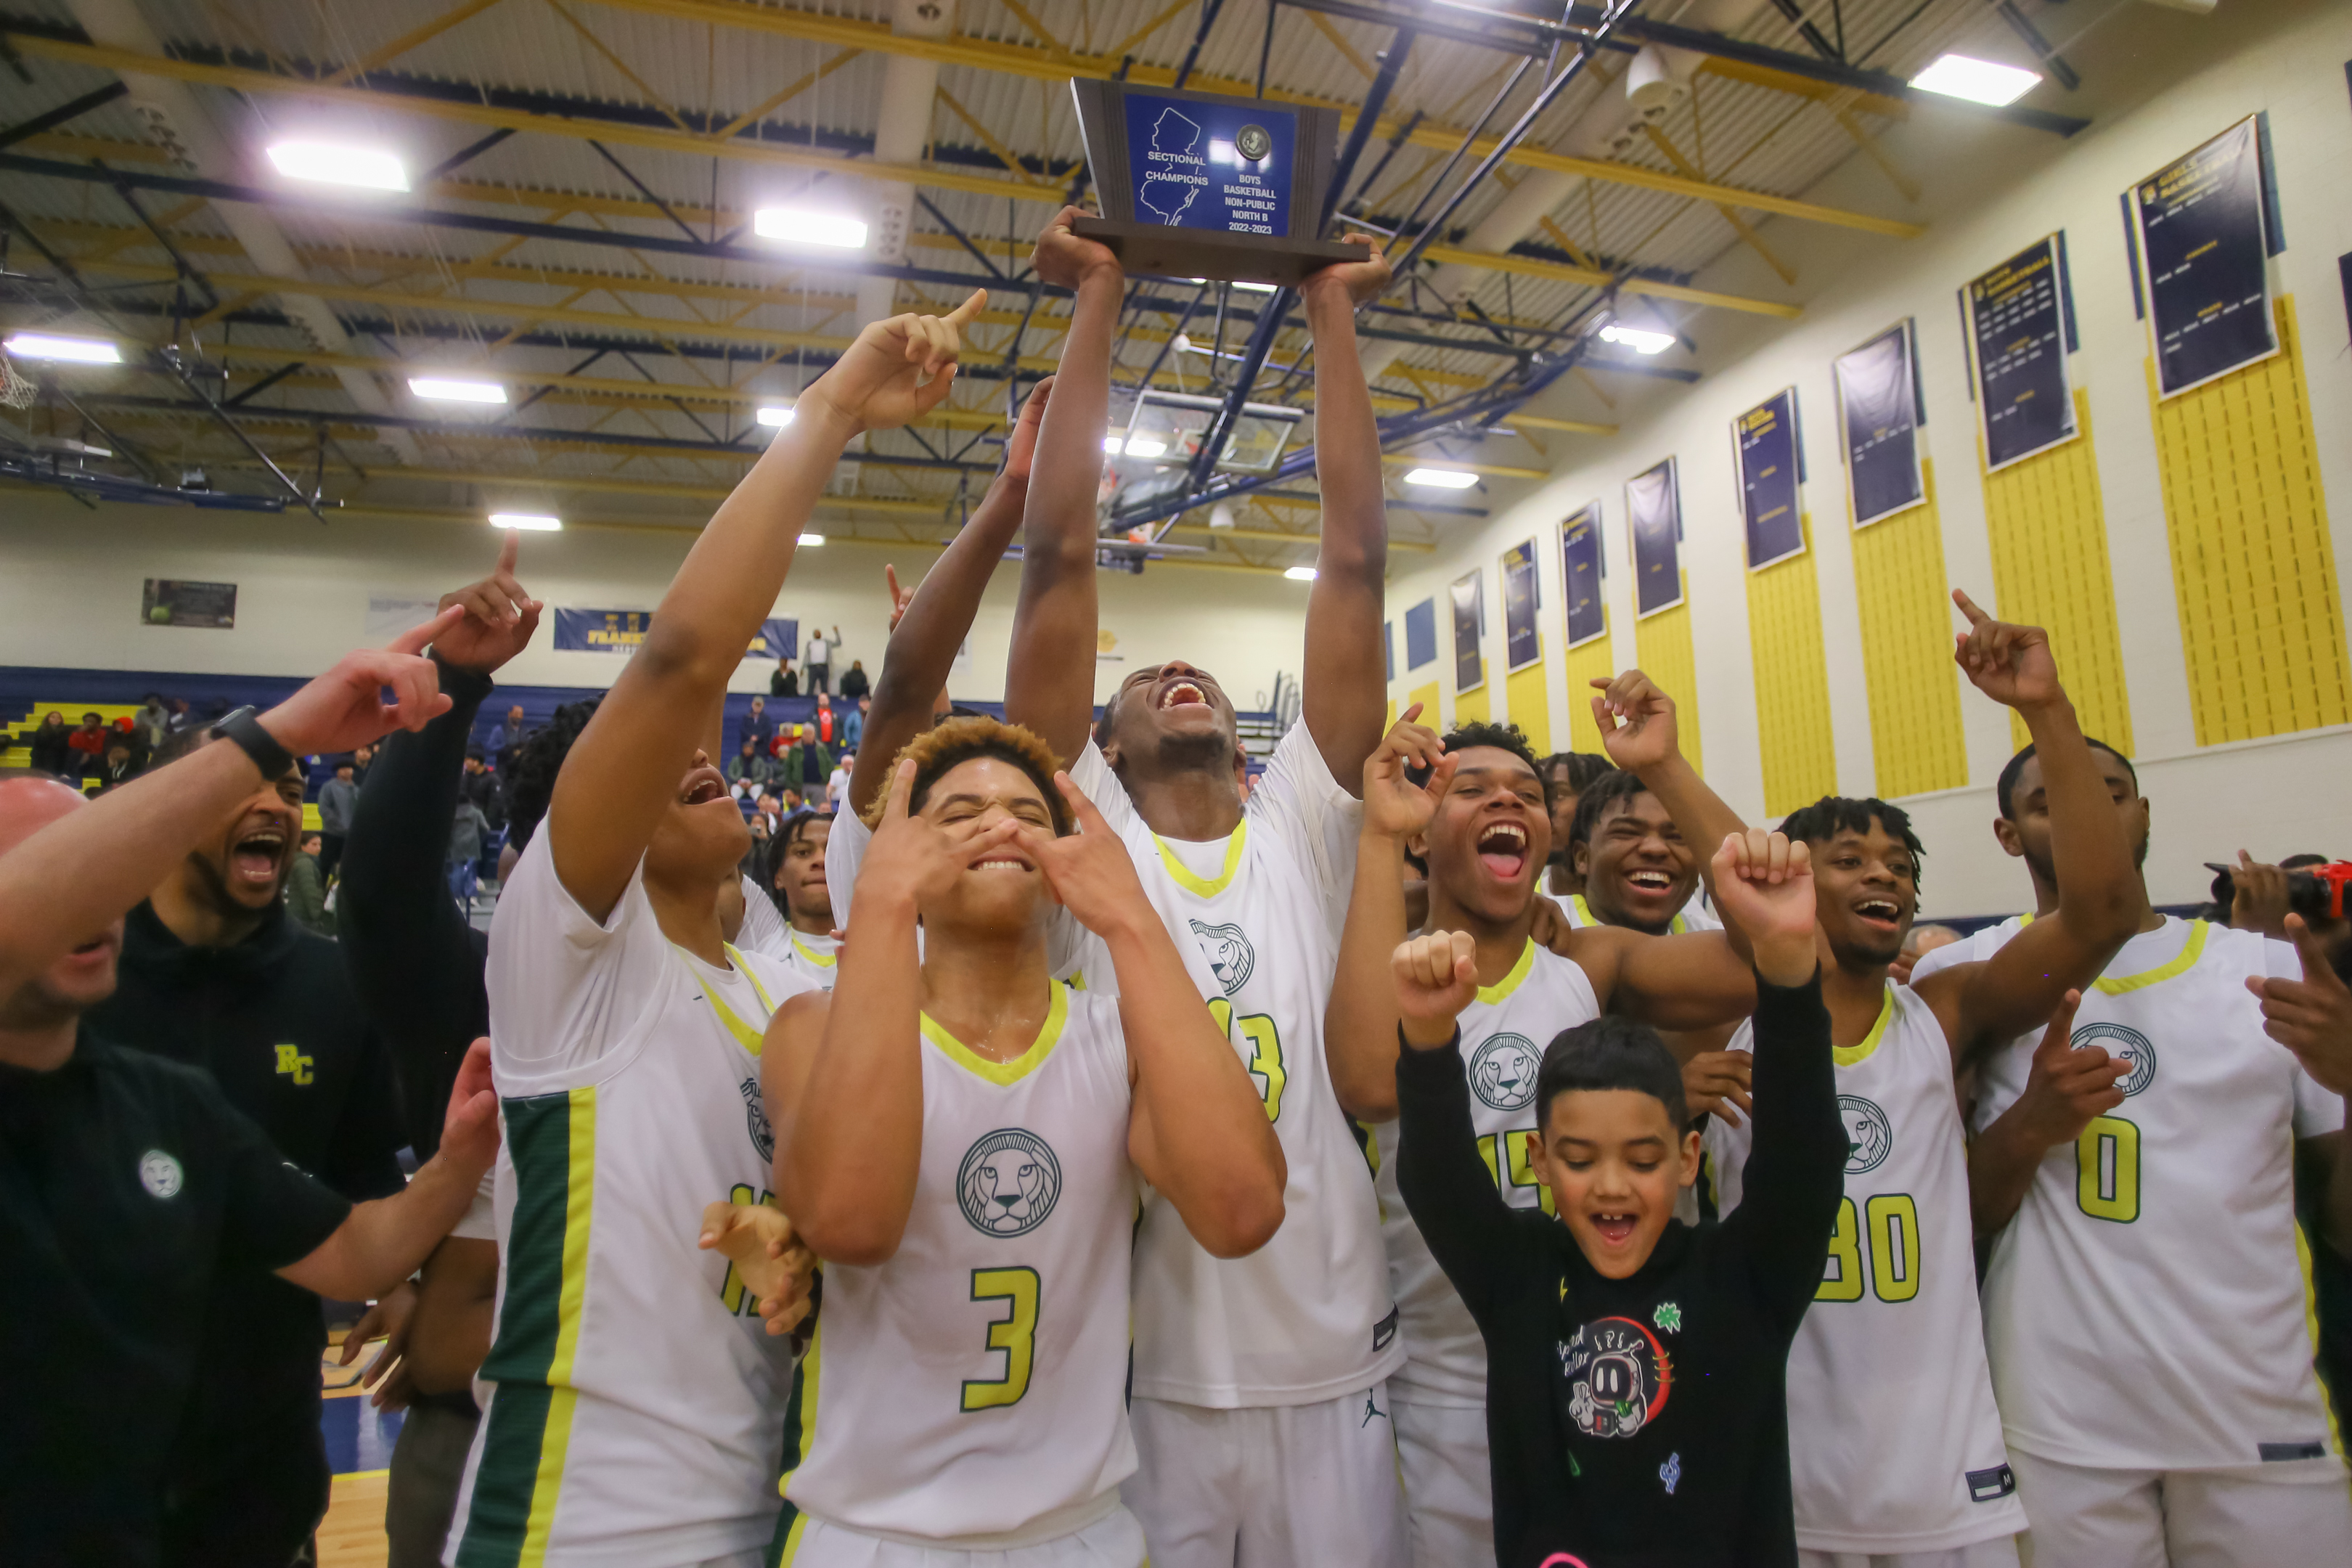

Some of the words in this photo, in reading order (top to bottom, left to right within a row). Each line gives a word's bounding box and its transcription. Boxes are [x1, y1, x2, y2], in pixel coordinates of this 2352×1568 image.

[1148, 151, 1206, 166] SECTIONAL
[1146, 171, 1209, 186] CHAMPIONS
[1239, 174, 1261, 184] BOYS
[1223, 184, 1277, 199] BASKETBALL
[1225, 197, 1275, 211] NON-PUBLIC
[1232, 210, 1260, 221] NORTH
[1228, 222, 1272, 234] 2022-2023
[274, 1044, 314, 1085] RC
[2075, 1115, 2141, 1225] 0
[960, 1265, 1042, 1413] 3
[2003, 1474, 2012, 1486] M
